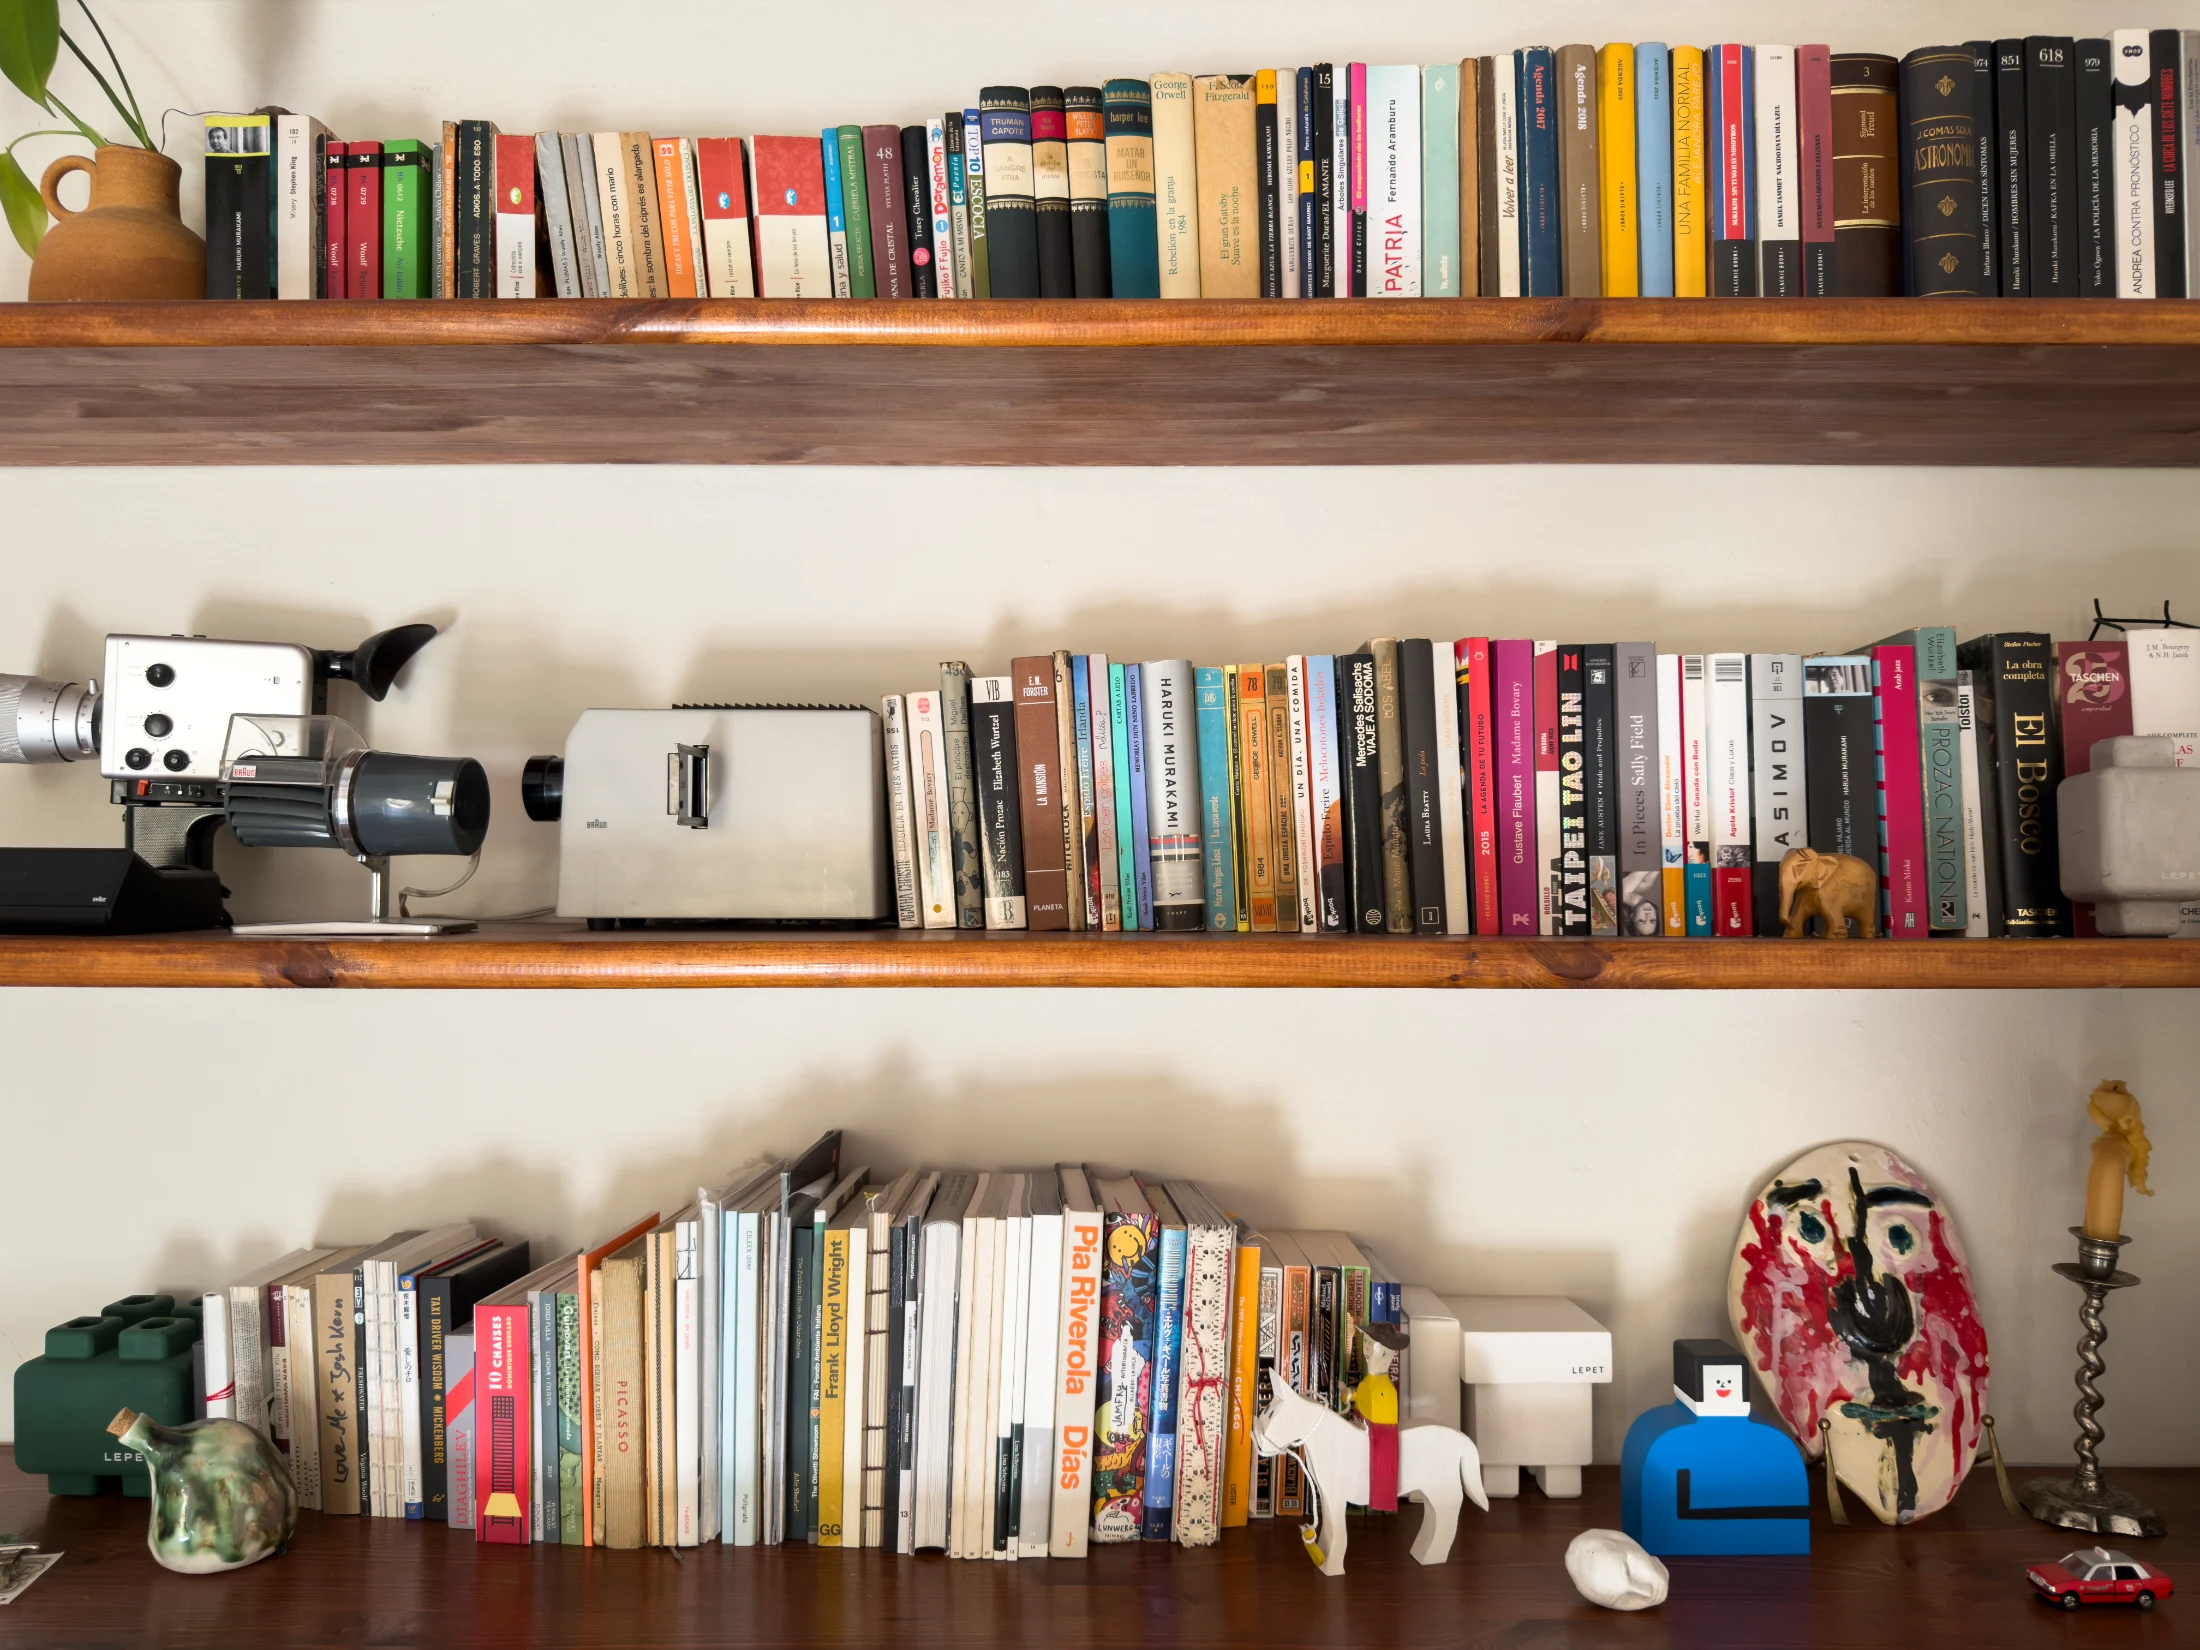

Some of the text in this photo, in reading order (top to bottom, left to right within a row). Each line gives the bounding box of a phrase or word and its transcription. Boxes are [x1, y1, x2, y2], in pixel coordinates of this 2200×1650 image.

[2001, 55, 2020, 66] 851
[2039, 48, 2064, 63] 618
[1154, 80, 1188, 100] George Orwell
[1205, 91, 1250, 102] Fitzgerald
[1532, 64, 1546, 130] Agenda 2017
[1577, 64, 1587, 130] Agenda 2018
[990, 118, 1024, 136] TRUMAN CAPOTE
[1110, 112, 1148, 123] harper lee
[1692, 63, 1702, 184] ALEJANDRA PAREJO
[1859, 110, 1875, 138] Sigmund Freud
[631, 144, 645, 181] alargada
[1113, 148, 1151, 182] MATAR UN RUISEÑOR
[1337, 99, 1346, 210] Árboles Singulares de Galicia
[1677, 63, 1692, 235] UNA FAMILIA NORMAL
[637, 184, 644, 193] es
[637, 197, 649, 222] ciprés
[847, 144, 861, 221] GABRIELA MISTRAL
[968, 129, 985, 240] TOP 10 ESCOCIA
[1385, 99, 1403, 292] PATRIA Fernando Aramburu
[2128, 124, 2143, 294] ANDREA CONTRA PRONÓSTICO
[642, 225, 650, 237] del
[1178, 214, 1187, 235] 1984
[1321, 158, 1332, 288] Marguerite Duras/EL AMANTE
[2009, 130, 2021, 290] Haruki Murakami HOMBRES SIN MUJERES
[643, 240, 654, 273] sombra
[834, 244, 845, 269] salud
[886, 222, 896, 275] DE CRISTAL
[2003, 672, 2045, 682] completa
[2006, 660, 2042, 669] La obra
[2070, 672, 2119, 682] TASCHEN
[1077, 701, 1088, 741] Irlanda
[1290, 666, 1305, 798] UN DÍA. UNA COMIDA
[1315, 671, 1330, 782] Melocotones helados
[1351, 662, 1367, 767] Mercedes Salisachs
[1363, 662, 1377, 756] VIAJE A SODOMA
[1511, 681, 1522, 764] Madame Bovary
[234, 766, 255, 778] BRAUN
[961, 736, 971, 780] destronado
[988, 714, 1003, 791] Elizabeth Wurtzel
[1160, 678, 1178, 828] HARUKI MURAKAMI
[1630, 714, 1648, 786] Sally Field
[1840, 735, 1850, 796] HARUKI MURAKAMI
[924, 772, 937, 829] Madame Bovary
[1034, 764, 1048, 806] LA MANSIÓN
[1079, 747, 1093, 818] Espido Freire
[1098, 760, 1112, 850] Los cien golpes
[1770, 713, 1790, 847] ASIMOV
[2013, 711, 2048, 856] El Bosco
[587, 819, 607, 828] BRAUN
[995, 799, 1007, 862] Nación Prozac
[1320, 788, 1334, 860] Espido Freire
[1512, 775, 1524, 864] Gustave Flaubert
[1561, 692, 1587, 926] TAIPEI TAO LIN
[1930, 727, 1958, 899] PROZAC NATION
[1257, 857, 1265, 878] 1984
[1481, 831, 1490, 856] 2015
[896, 859, 915, 922] AGATHA CHRISTIE
[814, 1304, 822, 1333] Italiano
[825, 1239, 843, 1401] Frank Lloyd Wright
[1355, 1273, 1363, 1317] MCDOWELL
[488, 1315, 503, 1390] 10 CHAISES
[563, 1305, 574, 1360] Guinovart
[1061, 1225, 1099, 1491] Pia Riverola Días
[357, 1366, 365, 1411] FRESHWATER
[430, 1296, 444, 1464] TAXI DRIVER WISDOM MICKENBERG
[813, 1363, 821, 1384] Fondo
[1572, 1366, 1604, 1374] LEPET
[616, 1380, 629, 1454] PICASSO
[812, 1424, 820, 1461] Showroom
[359, 1452, 369, 1501] Virginia Woolf
[455, 1428, 468, 1525] DIAGHILEV
[811, 1462, 819, 1485] Olivetti
[1229, 1484, 1237, 1506] LUSTER
[819, 1523, 841, 1536] GG
[900, 1510, 909, 1518] 13
[1097, 1522, 1134, 1533] LUNWERG
